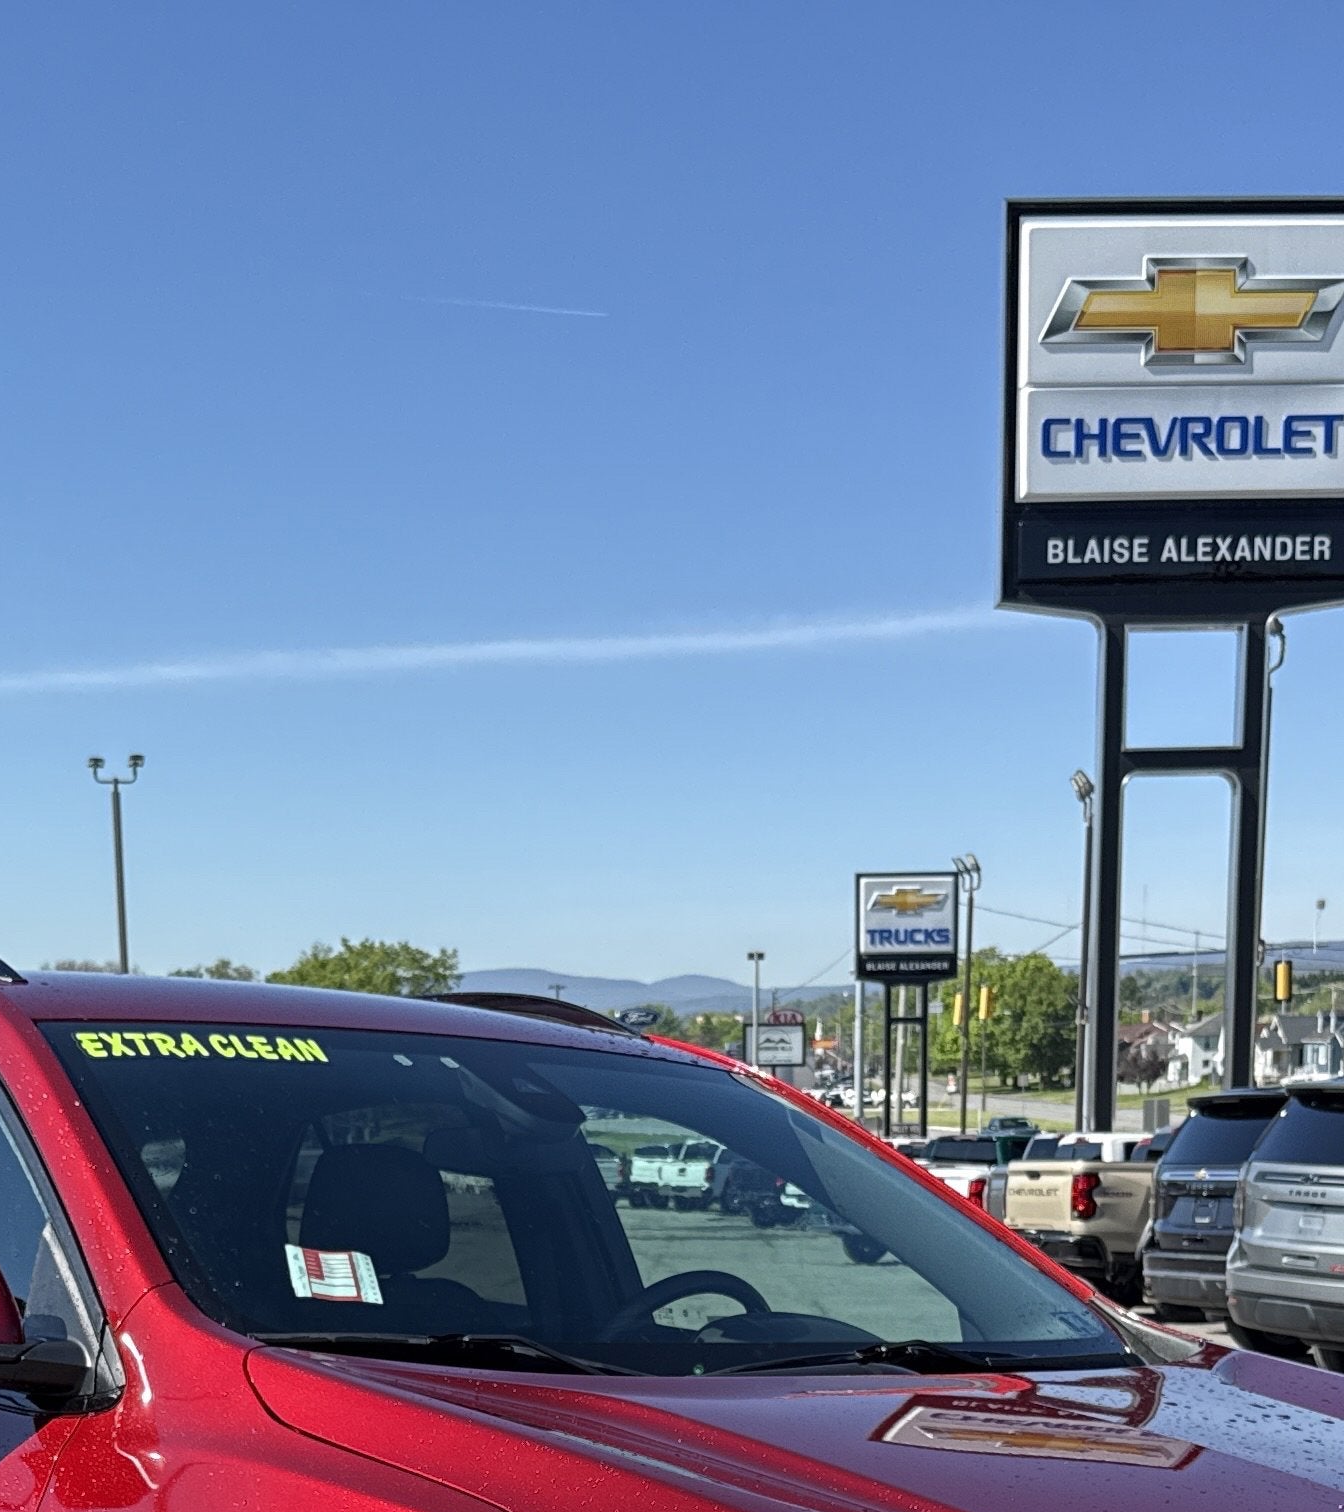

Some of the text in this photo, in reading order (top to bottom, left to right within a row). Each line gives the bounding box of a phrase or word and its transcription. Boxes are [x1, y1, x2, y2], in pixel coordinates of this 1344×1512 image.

[1046, 535, 1332, 564] BLAISE ALEXANDER
[866, 928, 951, 946] TRUCKS
[75, 1032, 329, 1063] EXTRA CLEAN
[1009, 1188, 1059, 1197] CHEVROLET
